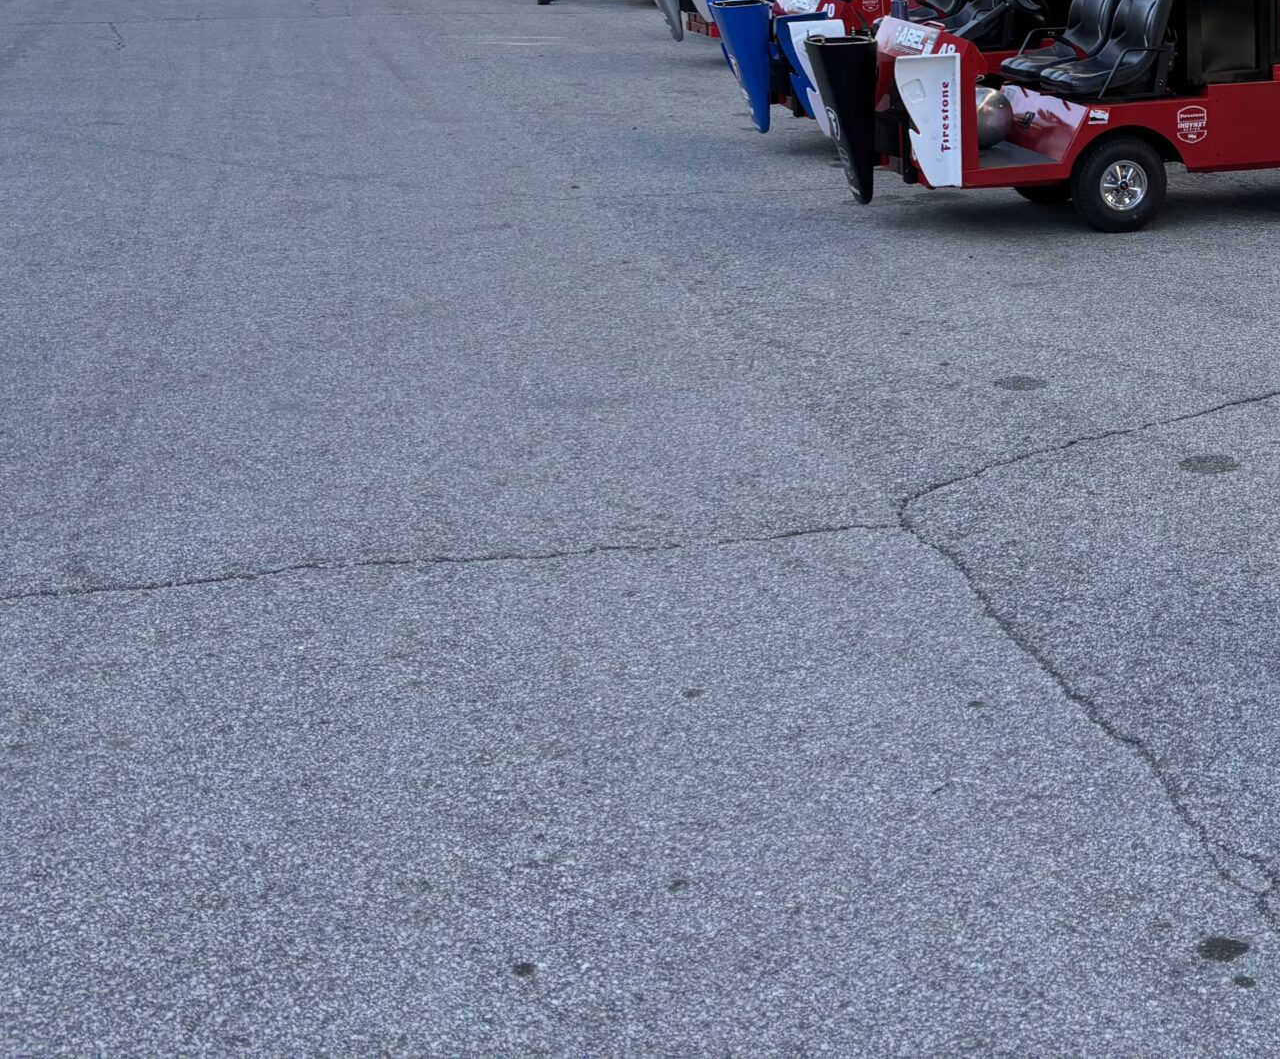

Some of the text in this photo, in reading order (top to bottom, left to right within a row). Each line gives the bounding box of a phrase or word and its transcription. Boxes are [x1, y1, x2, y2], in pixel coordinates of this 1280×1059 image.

[821, 2, 836, 18] 40
[897, 26, 926, 49] ABEL
[941, 81, 951, 152] Firestone
